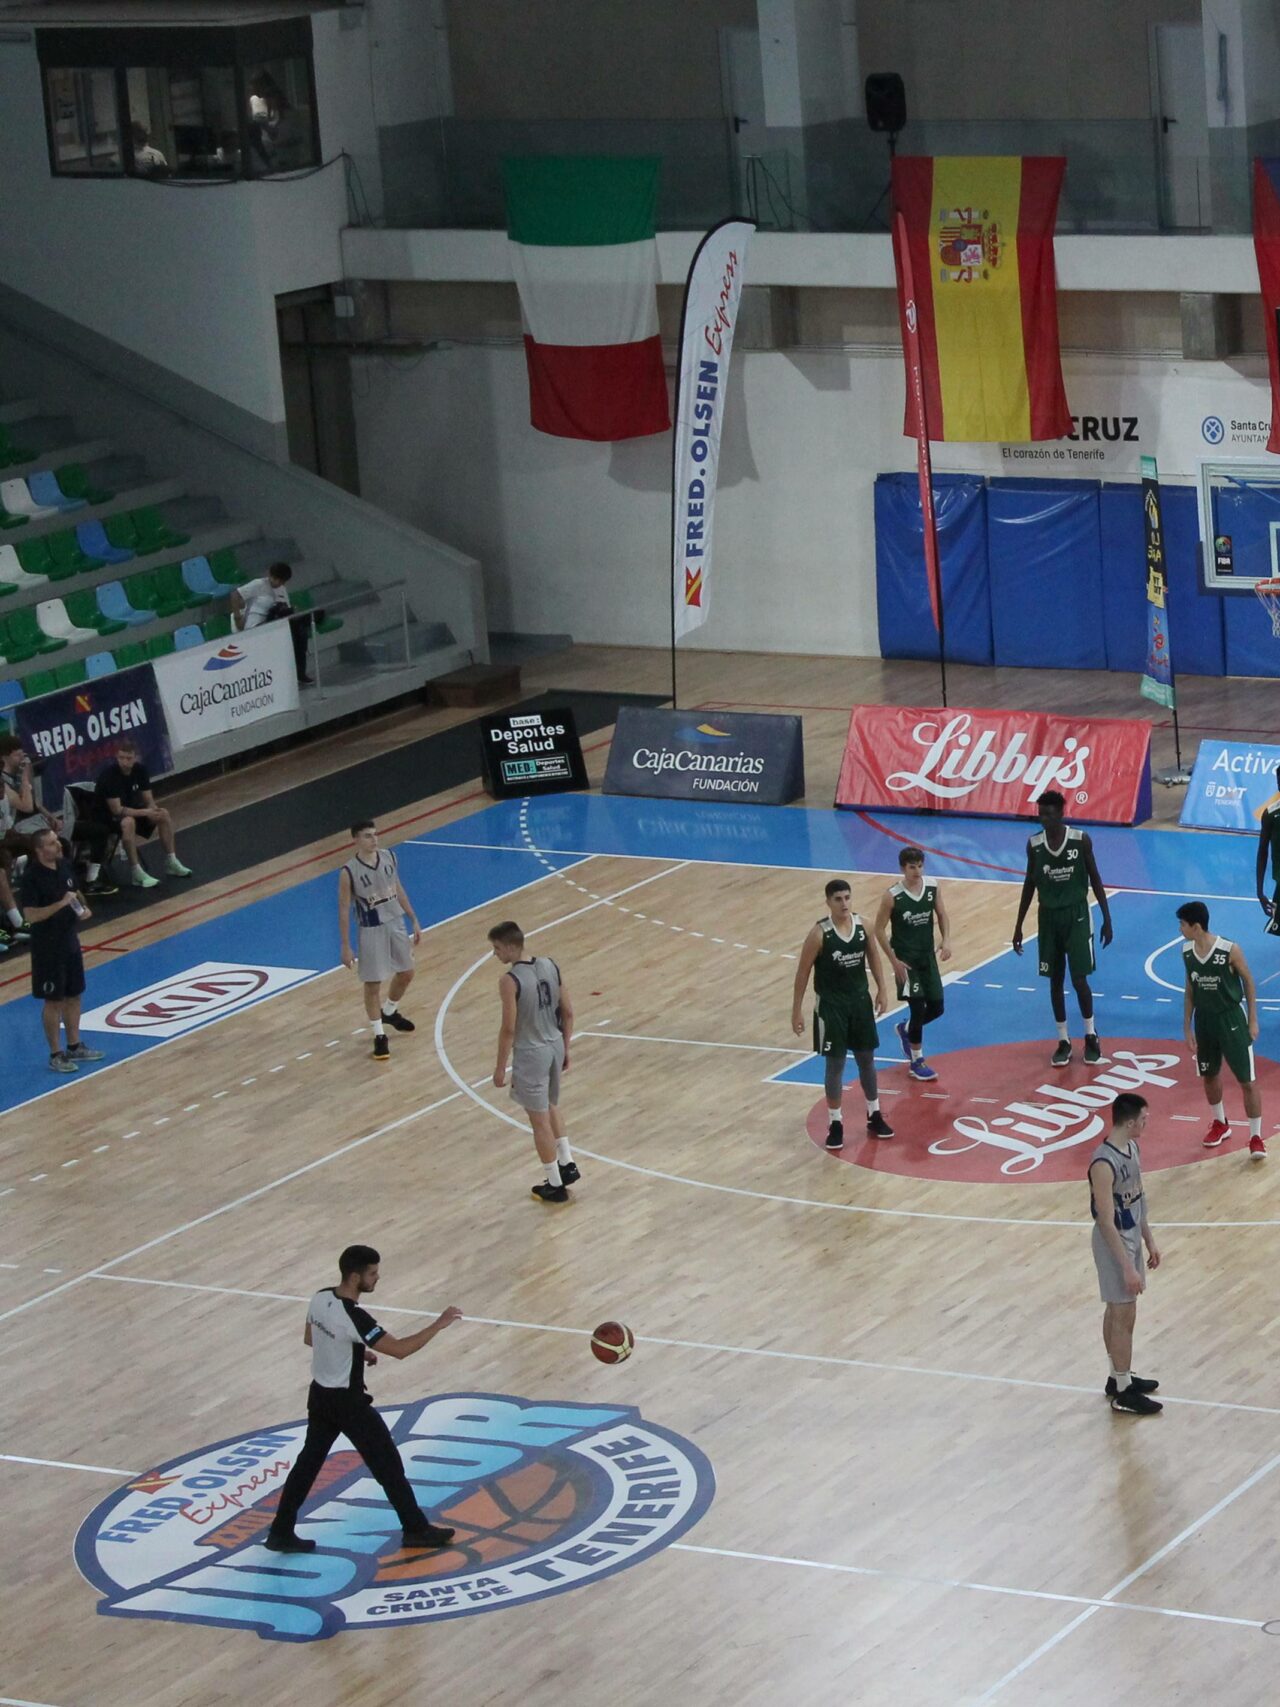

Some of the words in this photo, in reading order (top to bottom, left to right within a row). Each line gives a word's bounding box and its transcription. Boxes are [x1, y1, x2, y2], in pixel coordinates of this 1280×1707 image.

[704, 249, 737, 355] Express
[690, 361, 719, 459] OLSEN
[1231, 420, 1257, 431] Santa
[1258, 421, 1272, 431] Cru
[1231, 434, 1269, 443] AYUNTAM
[1002, 448, 1011, 458] El
[1014, 448, 1050, 459] corazón
[1053, 449, 1065, 459] de
[1067, 449, 1104, 460] Tenerife
[180, 669, 273, 716] CajaCanarias
[231, 693, 274, 718] FUNDACIÓN
[87, 699, 147, 741] OLSEN
[507, 737, 555, 754] Salud
[632, 747, 765, 775] CajaCanarias
[692, 778, 760, 792] FUNDACIÓN
[1066, 849, 1079, 860] 30
[927, 891, 933, 901] 5
[858, 930, 866, 941] 3
[1040, 962, 1048, 972] 30
[1212, 953, 1226, 965] 35
[913, 982, 919, 993] 5
[182, 1433, 297, 1490] OLSEN
[180, 1460, 290, 1524] Express
[509, 1435, 681, 1582] TENERIFE
[366, 1595, 459, 1616] CRUZ
[467, 1584, 512, 1600] DE
[384, 1577, 502, 1602] SANTA
